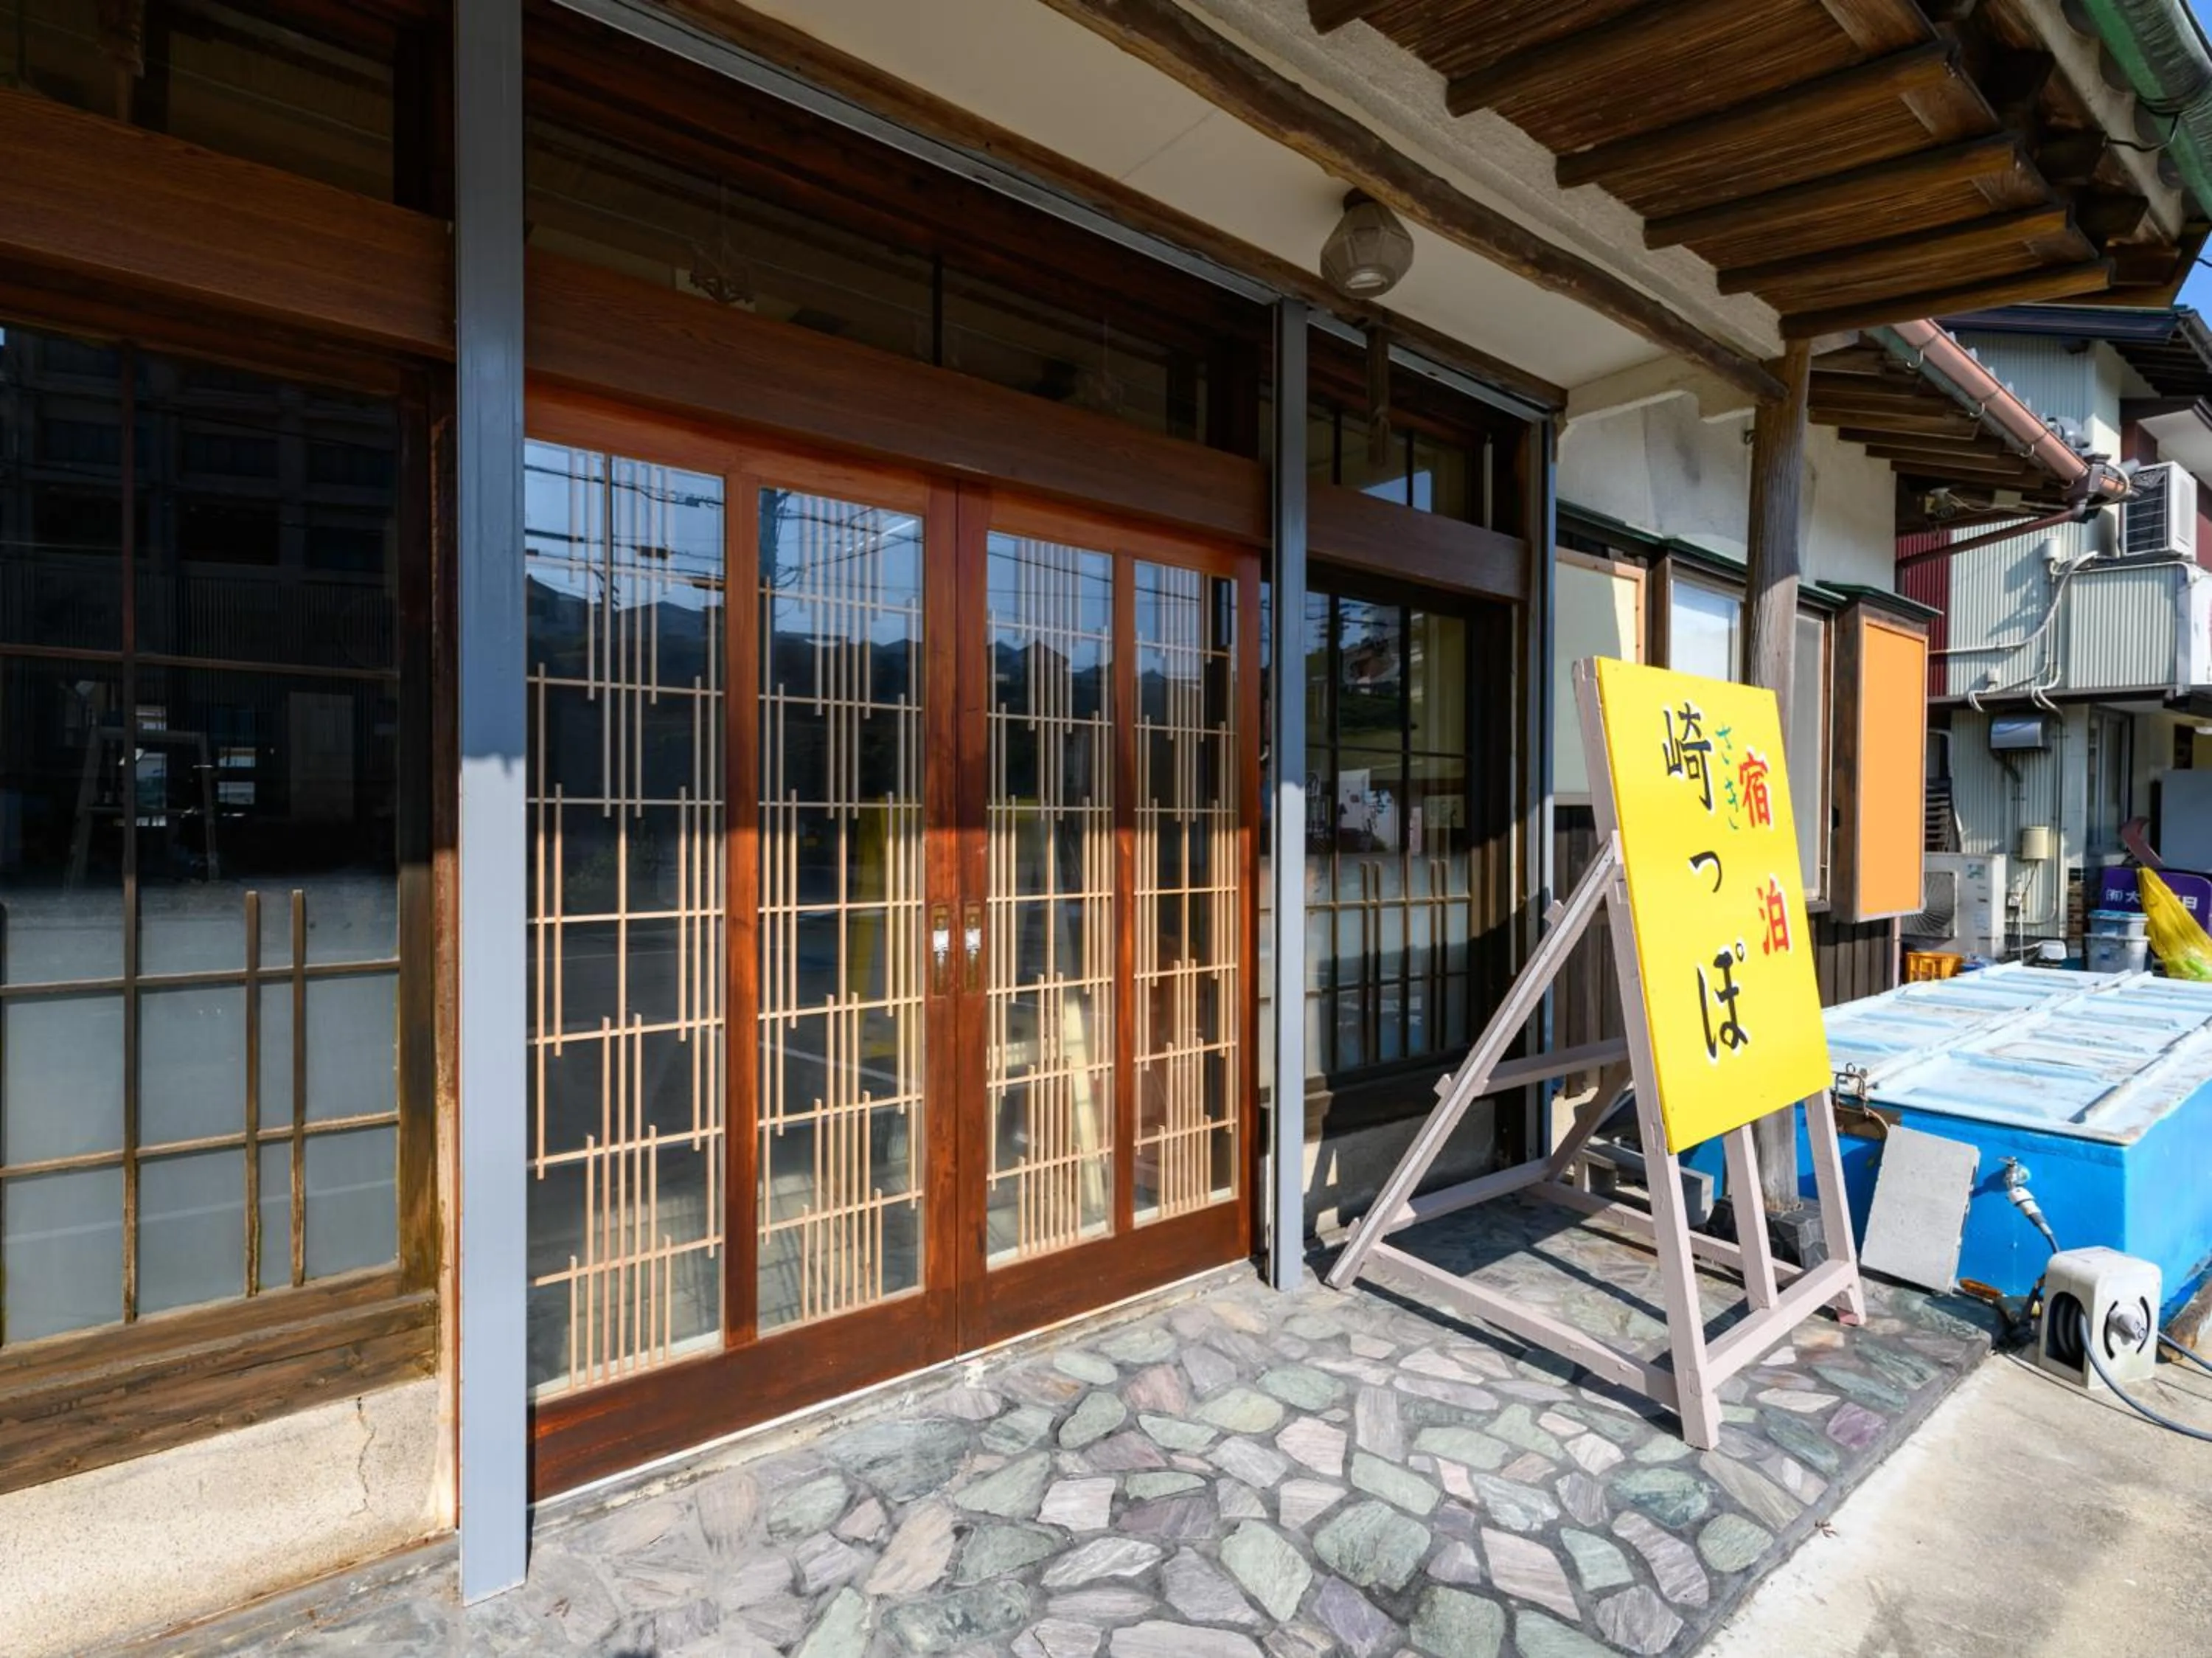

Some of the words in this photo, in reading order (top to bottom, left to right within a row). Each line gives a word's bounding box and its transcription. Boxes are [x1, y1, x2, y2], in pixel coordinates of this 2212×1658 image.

[1662, 701, 1750, 1059] 崎っぽ
[1738, 751, 1791, 956] 宿泊
